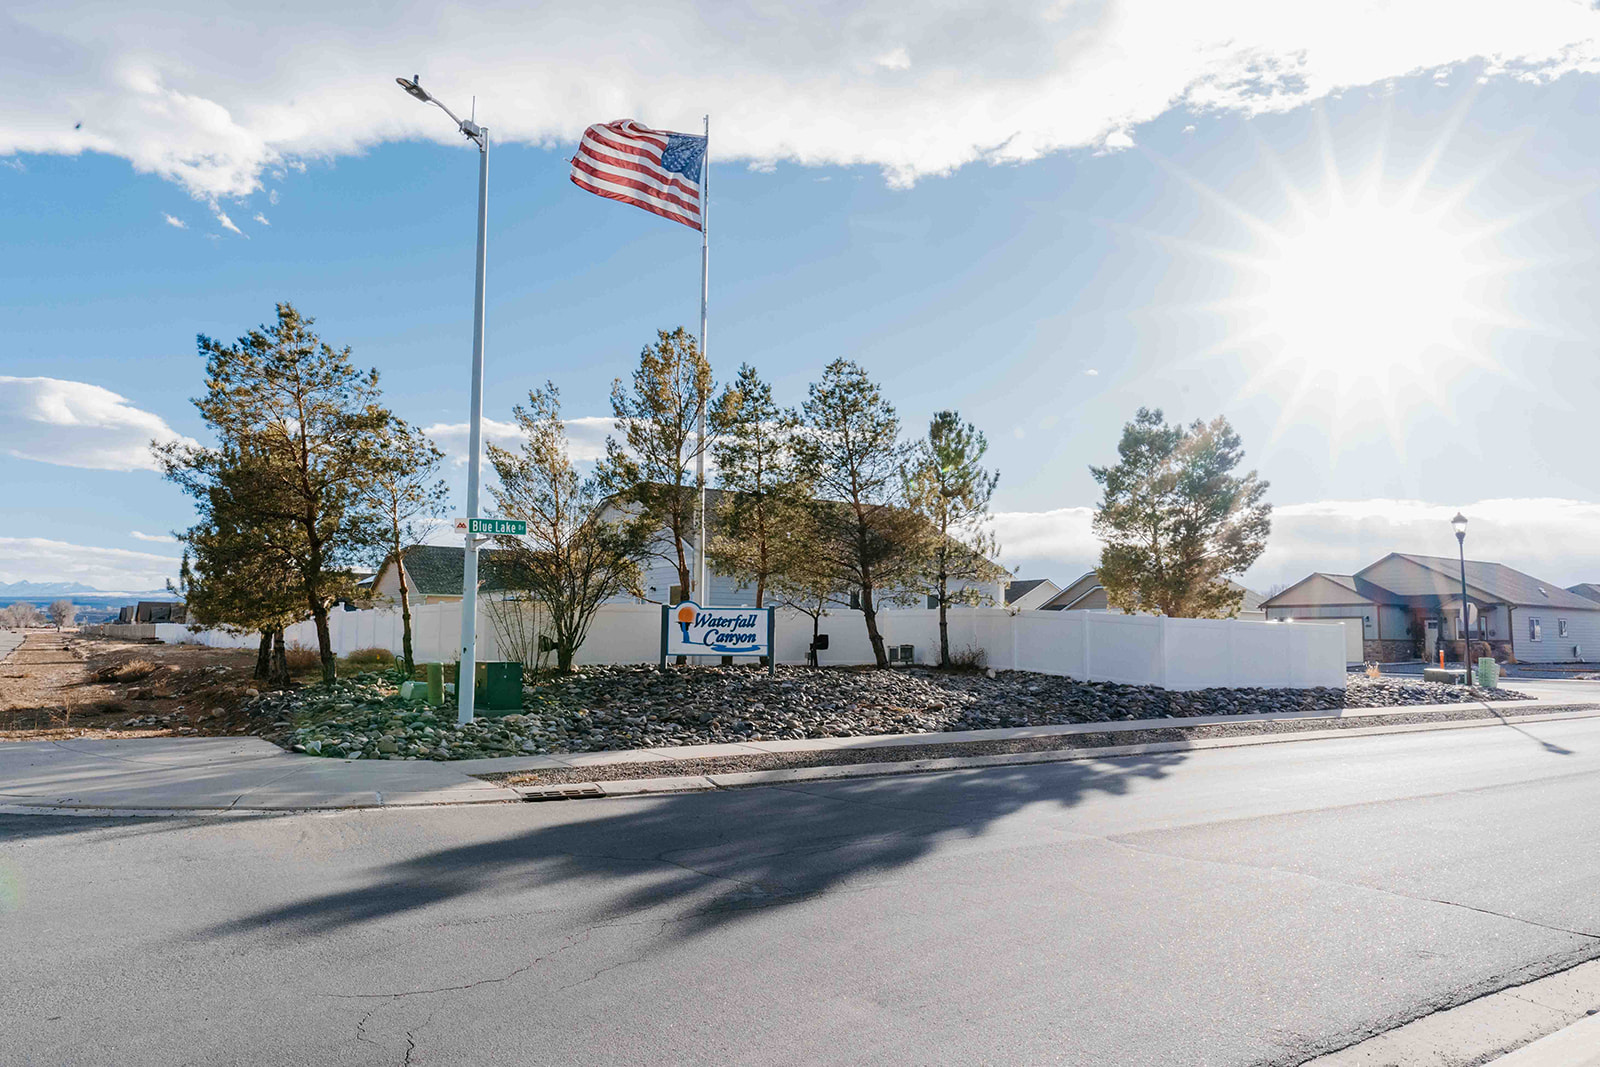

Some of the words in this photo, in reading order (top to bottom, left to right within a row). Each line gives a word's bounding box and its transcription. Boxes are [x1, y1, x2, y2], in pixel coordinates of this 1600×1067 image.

[472, 520, 493, 532] Blue
[495, 521, 516, 533] Lake
[694, 612, 758, 632] Waterfall
[703, 629, 757, 646] Canyon
